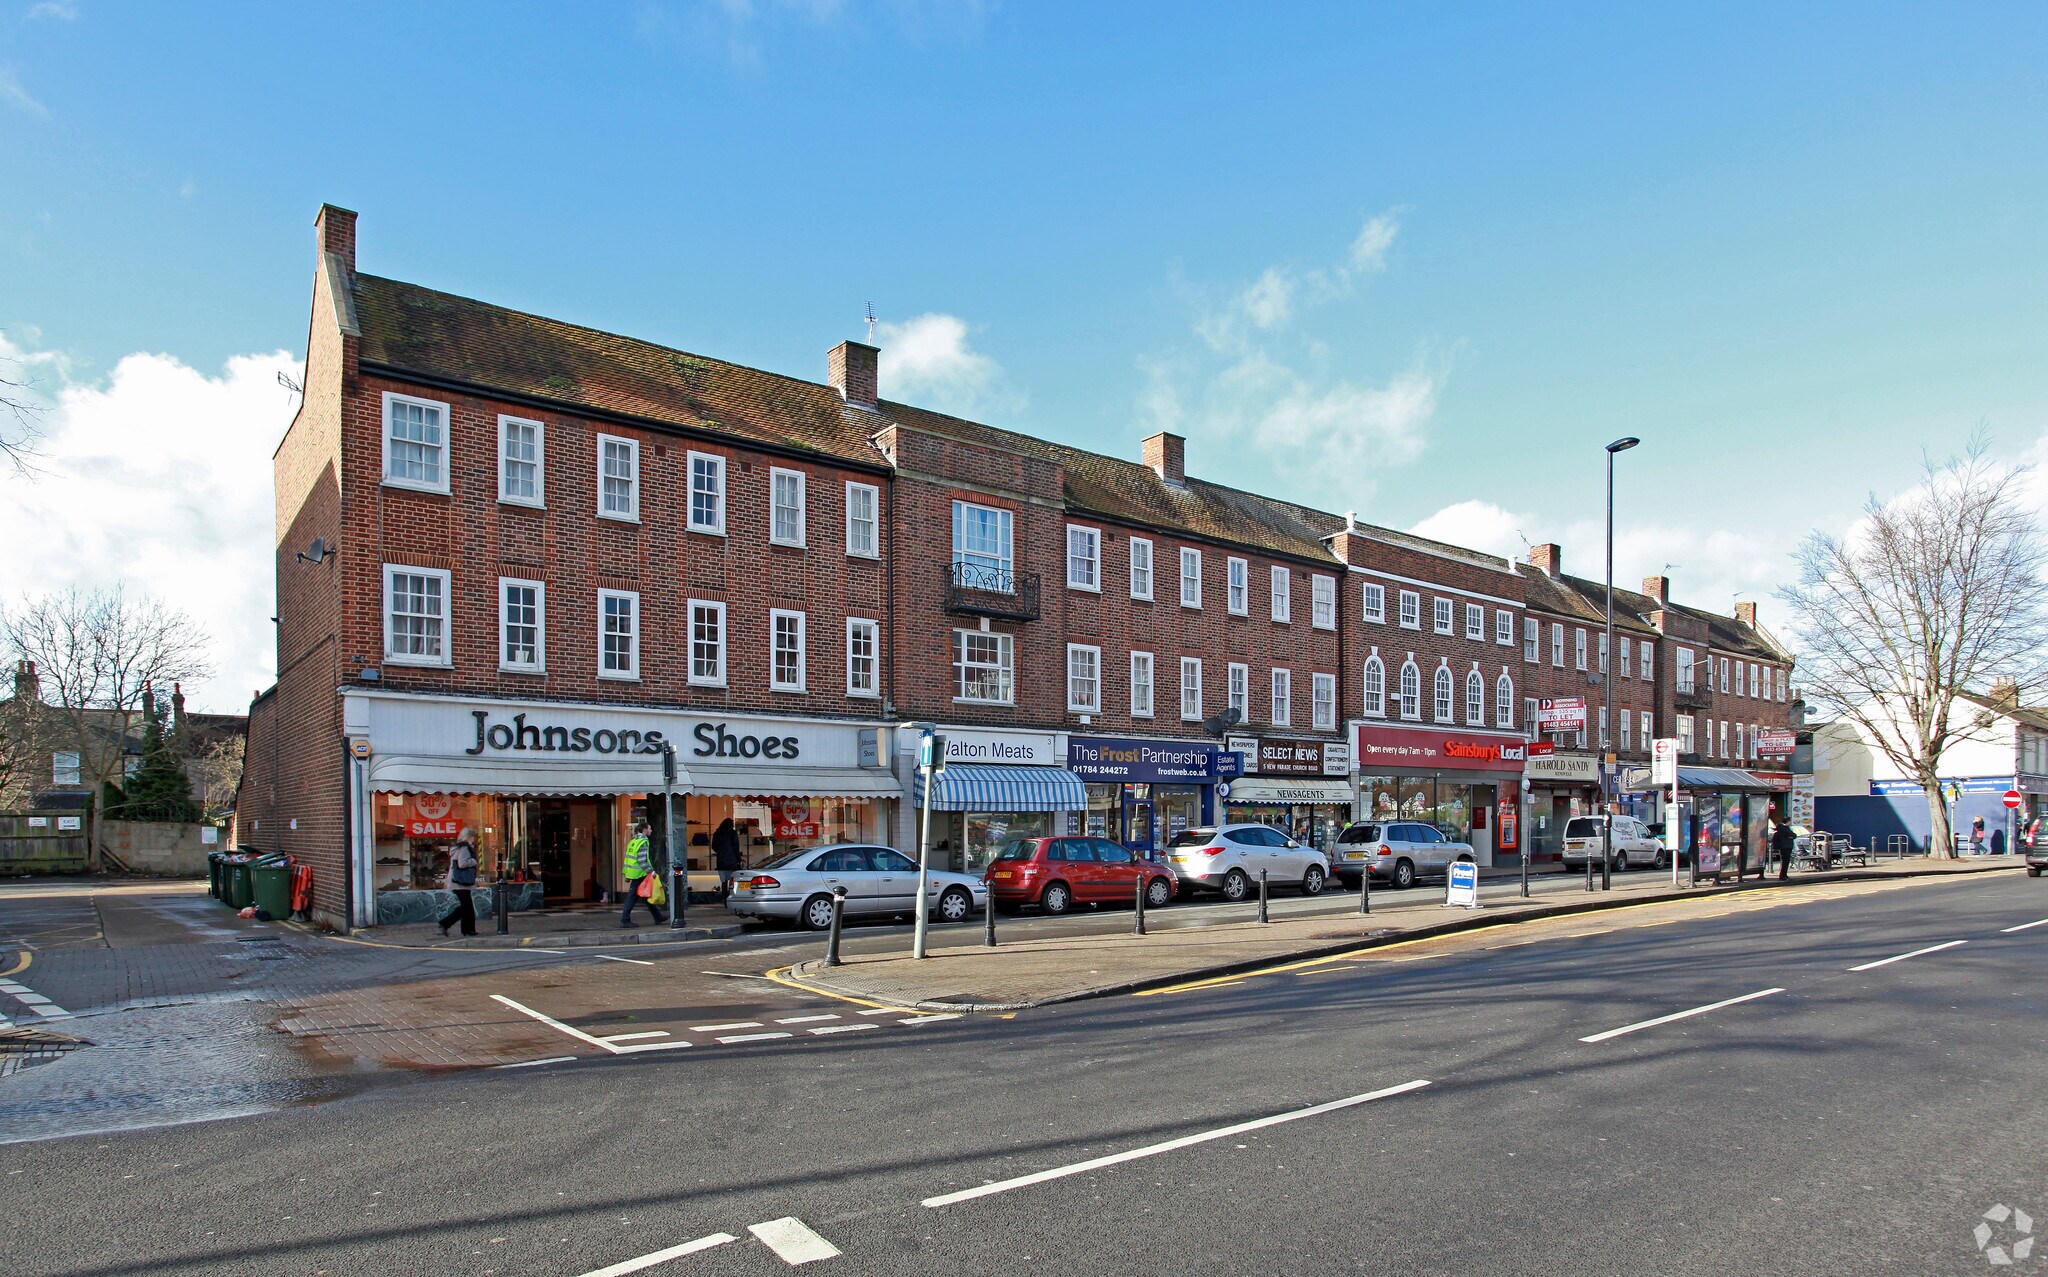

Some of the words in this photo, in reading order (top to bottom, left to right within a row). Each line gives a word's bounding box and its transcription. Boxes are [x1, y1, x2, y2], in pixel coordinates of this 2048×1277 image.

[466, 710, 664, 755] Johnsons
[693, 722, 800, 759] Shoes
[861, 738, 877, 748] Johnsons
[945, 740, 987, 757] alton
[991, 742, 1034, 759] Meats
[1262, 746, 1293, 760] SELECT
[1295, 748, 1318, 761] NEWS
[1366, 743, 1382, 754] Open
[1382, 745, 1397, 756] every
[1397, 745, 1408, 757] day
[1408, 746, 1420, 755] 7am
[1424, 747, 1437, 757] 11pm
[1444, 741, 1500, 762] Sainsbury's
[1500, 744, 1524, 761] Local
[1073, 744, 1098, 761] The
[1100, 746, 1139, 763] Frost
[1141, 747, 1208, 768] Partnership
[1217, 756, 1235, 764] Estate
[1073, 765, 1098, 774] 01784
[1099, 766, 1129, 775] 244272
[1157, 767, 1207, 777] frostweb.co.uk
[1216, 764, 1236, 773] Agents
[1535, 760, 1566, 771] HAROLD
[1567, 760, 1590, 772] SANDY
[1277, 789, 1325, 799] NEWSAGENTS
[420, 795, 447, 808] 50%
[786, 804, 806, 814] 50%
[412, 822, 457, 835] SALE
[781, 825, 814, 836] SALE
